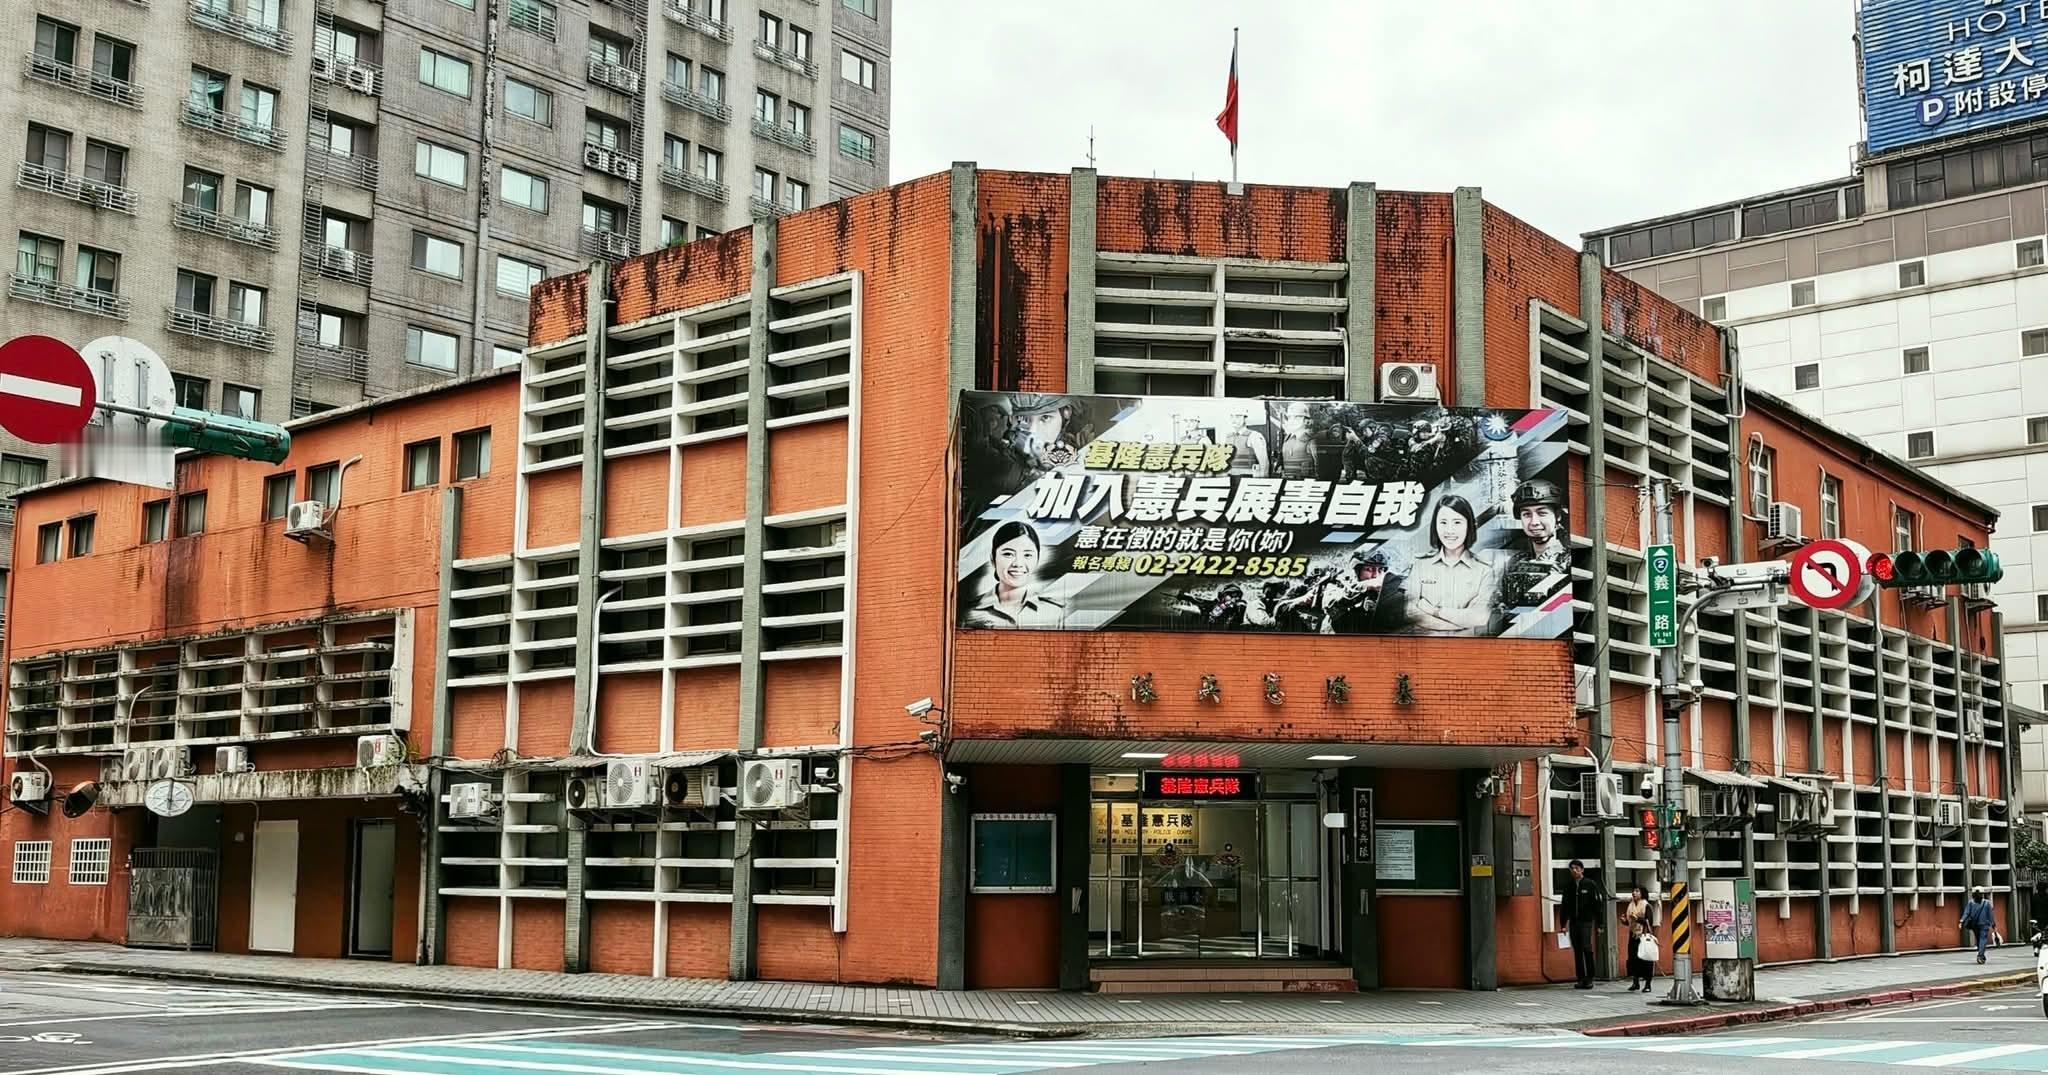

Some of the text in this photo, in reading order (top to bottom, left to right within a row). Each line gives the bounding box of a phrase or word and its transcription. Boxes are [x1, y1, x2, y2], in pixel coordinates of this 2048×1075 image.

[1084, 440, 1234, 473] 基隆憲兵隊
[1025, 470, 1425, 527] 加入憲兵展憲自我
[1074, 524, 1294, 555] 憲在徵的就是你(妳)
[1072, 554, 1308, 578] 報名專線 02-2422-8585
[1653, 574, 1670, 631] 義一路
